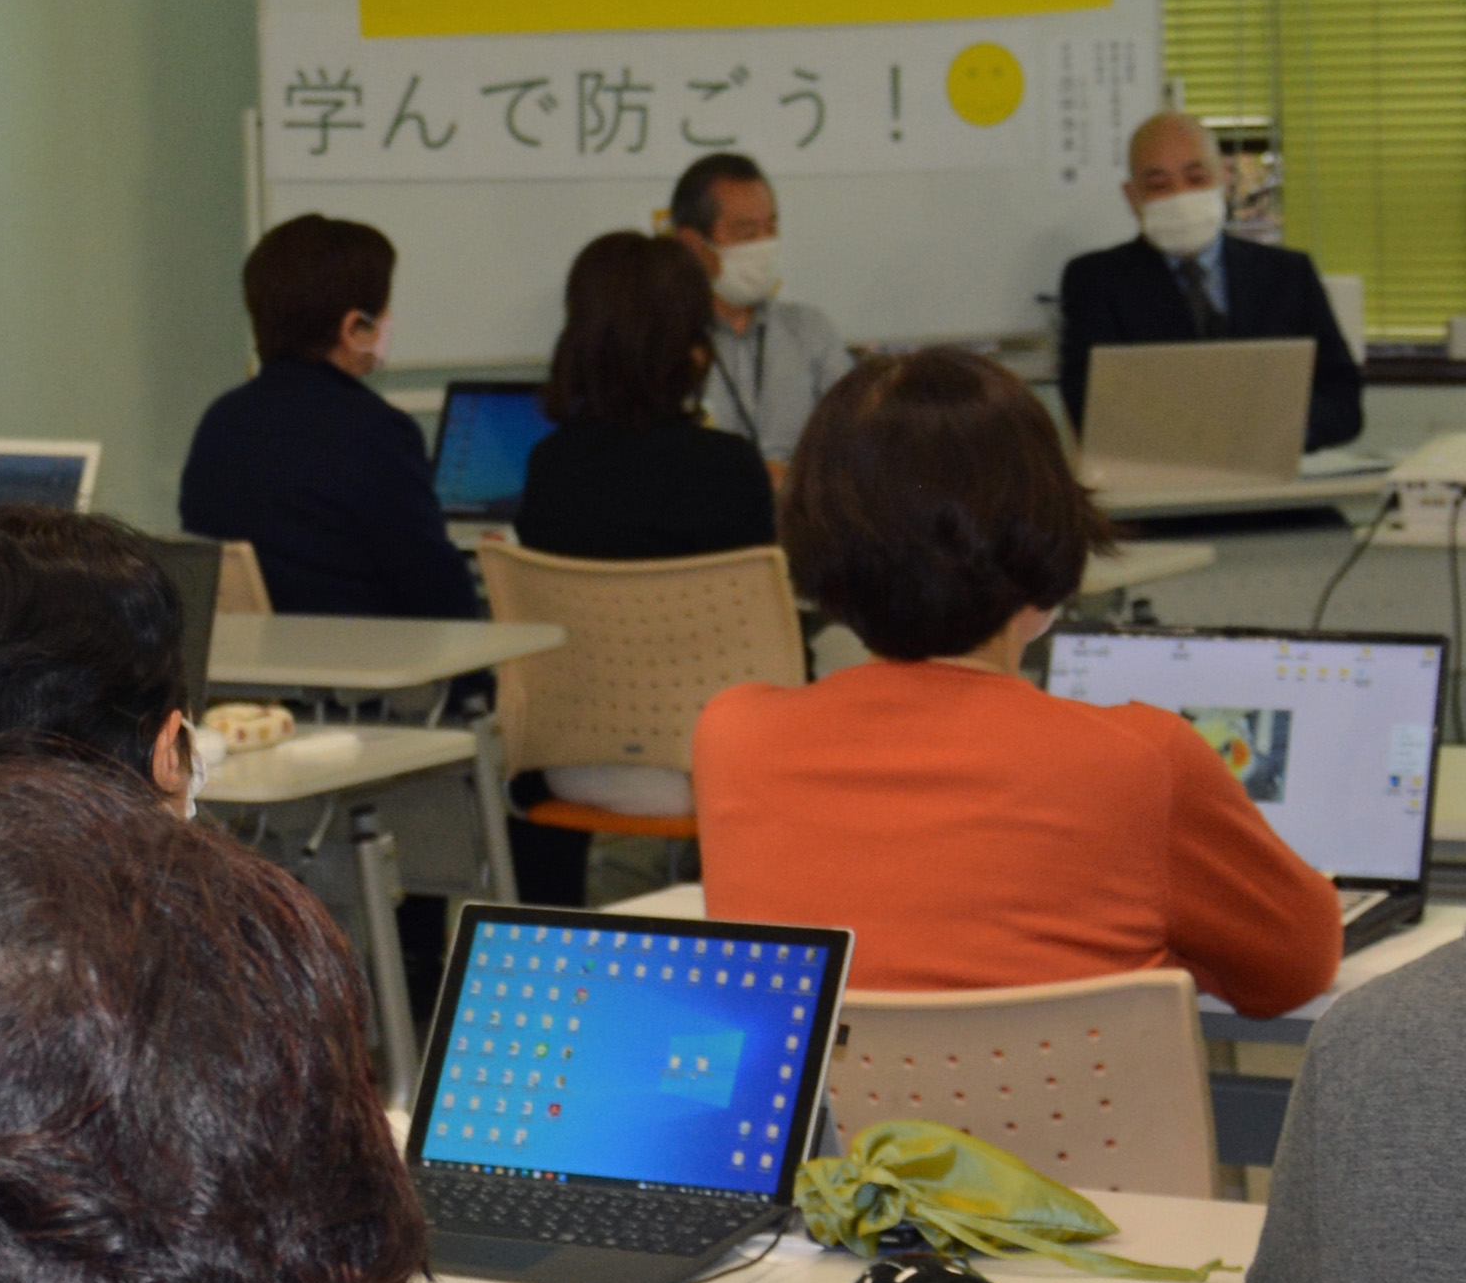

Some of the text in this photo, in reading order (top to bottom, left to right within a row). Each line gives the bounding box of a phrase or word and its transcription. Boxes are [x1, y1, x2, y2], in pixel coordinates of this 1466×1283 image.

[283, 62, 904, 155] 学んで防ごう！
